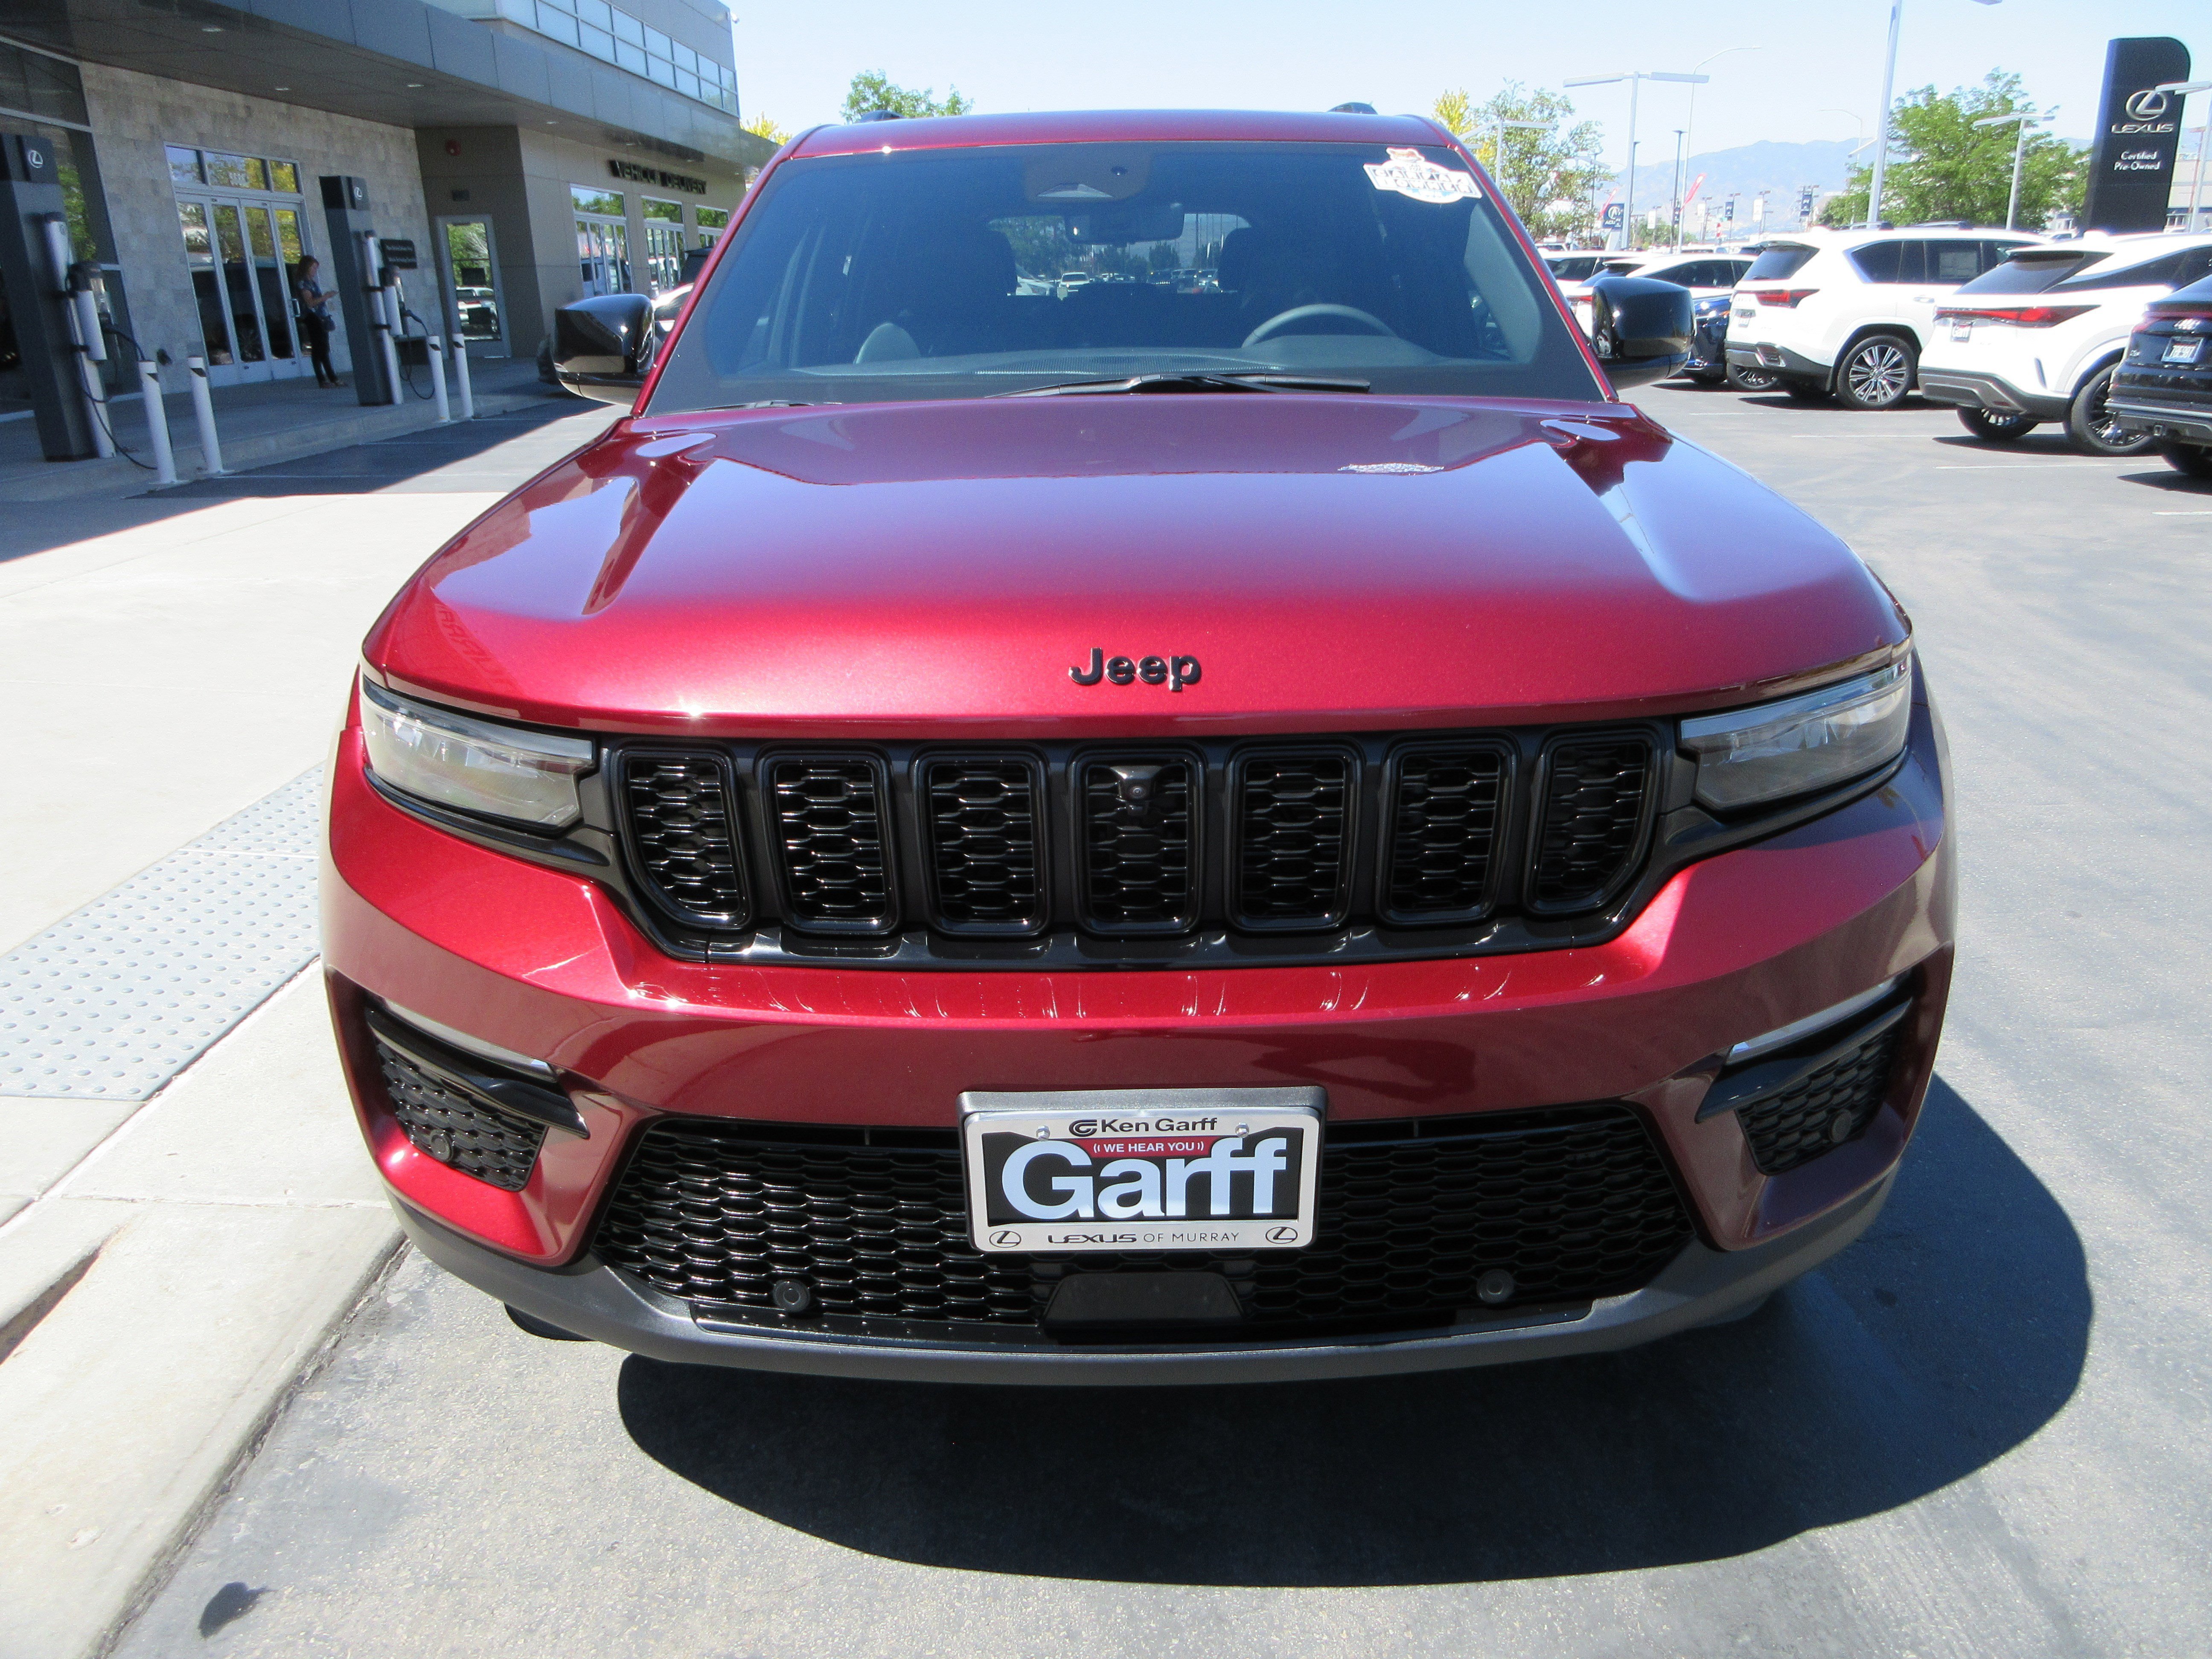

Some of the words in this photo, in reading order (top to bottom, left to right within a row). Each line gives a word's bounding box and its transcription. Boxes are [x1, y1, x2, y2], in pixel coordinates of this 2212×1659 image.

[2111, 124, 2174, 134] LEXUS
[2121, 151, 2158, 160] Certified
[2114, 160, 2162, 170] Pre-Owned
[1068, 647, 1202, 692] Jeep
[1101, 1119, 1149, 1132] Ken
[1155, 1118, 1218, 1132] Garff
[1104, 1144, 1125, 1153] WE
[1128, 1143, 1164, 1153] HEAR
[1167, 1142, 1194, 1152] YOU
[1002, 1137, 1286, 1220] Garff
[1048, 1233, 1137, 1243] LEXUS
[1143, 1233, 1164, 1243] OF
[1172, 1232, 1240, 1242] MURRAY
